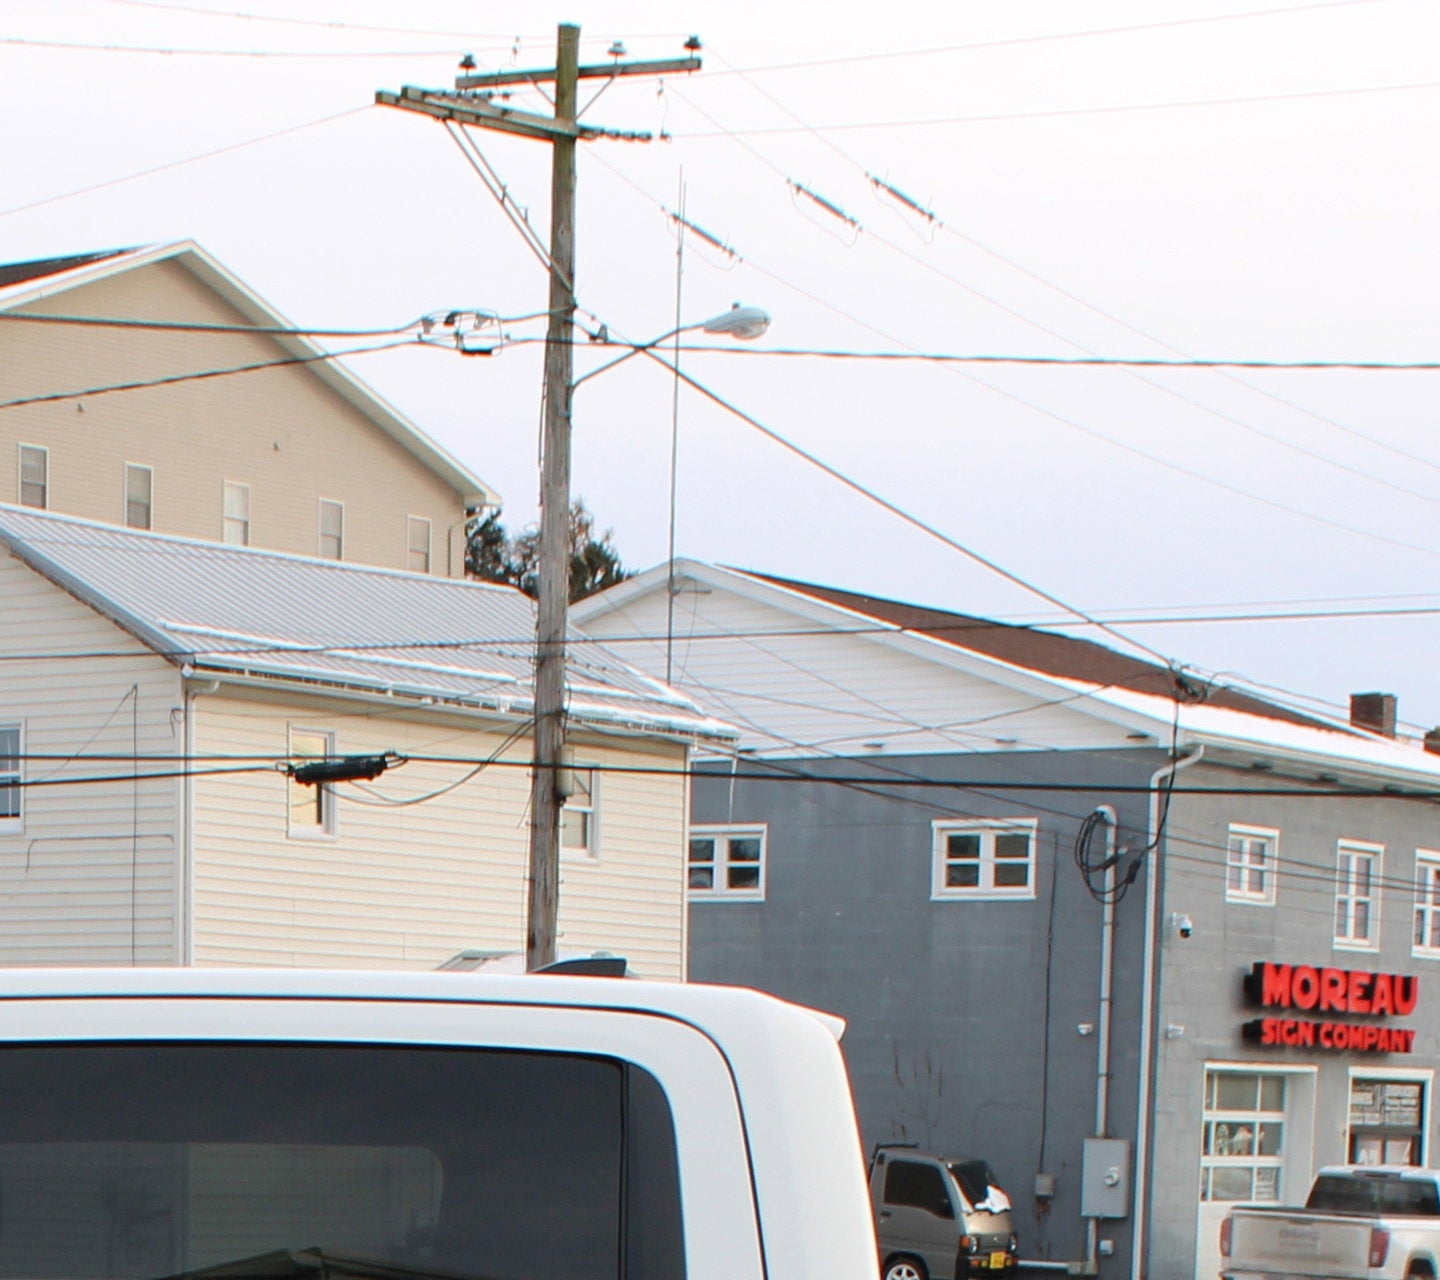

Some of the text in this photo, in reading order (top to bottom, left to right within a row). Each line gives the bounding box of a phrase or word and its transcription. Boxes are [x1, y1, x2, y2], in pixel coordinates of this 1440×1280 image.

[1262, 961, 1419, 1016] MOREAU
[1261, 1017, 1416, 1054] SIGN COMPANY
